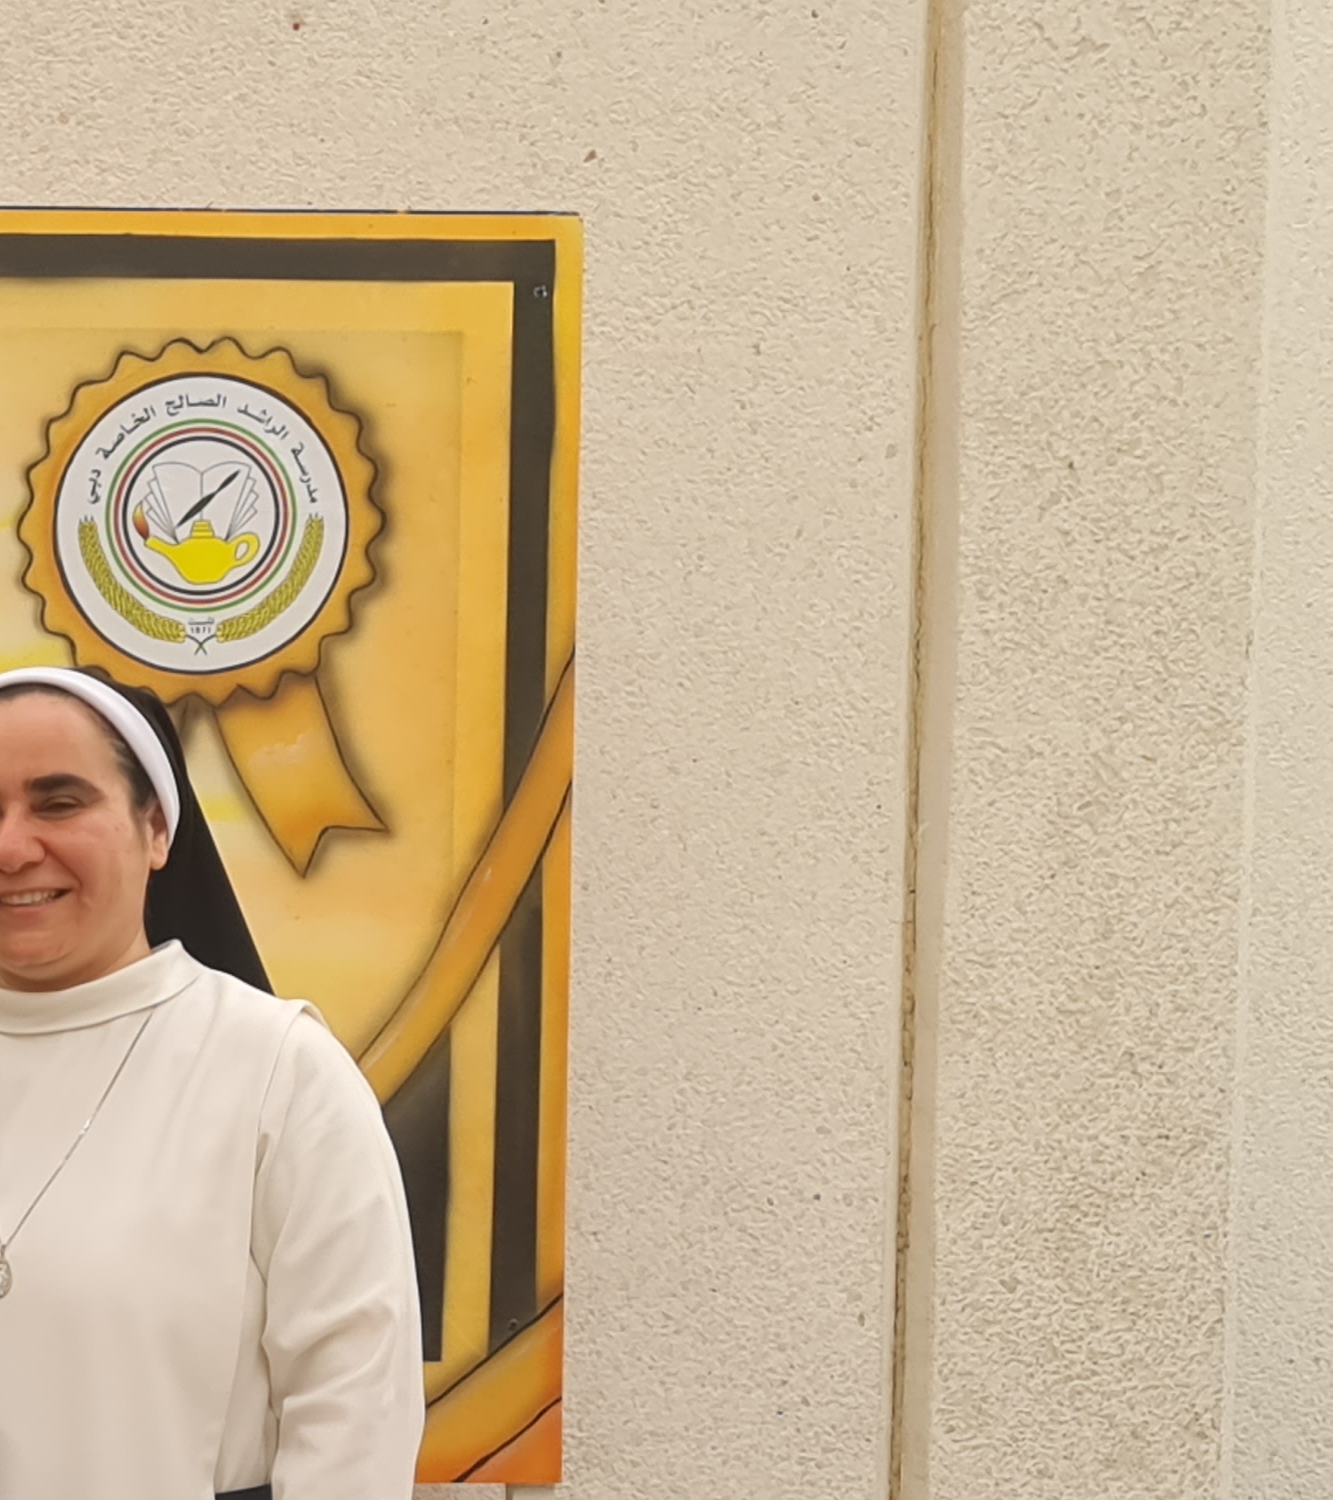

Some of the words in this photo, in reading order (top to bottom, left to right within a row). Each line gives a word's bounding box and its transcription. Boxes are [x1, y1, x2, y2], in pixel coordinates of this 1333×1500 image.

[164, 393, 227, 417] الصالح
[237, 403, 290, 441] الراشد
[94, 404, 157, 461] الخاصة
